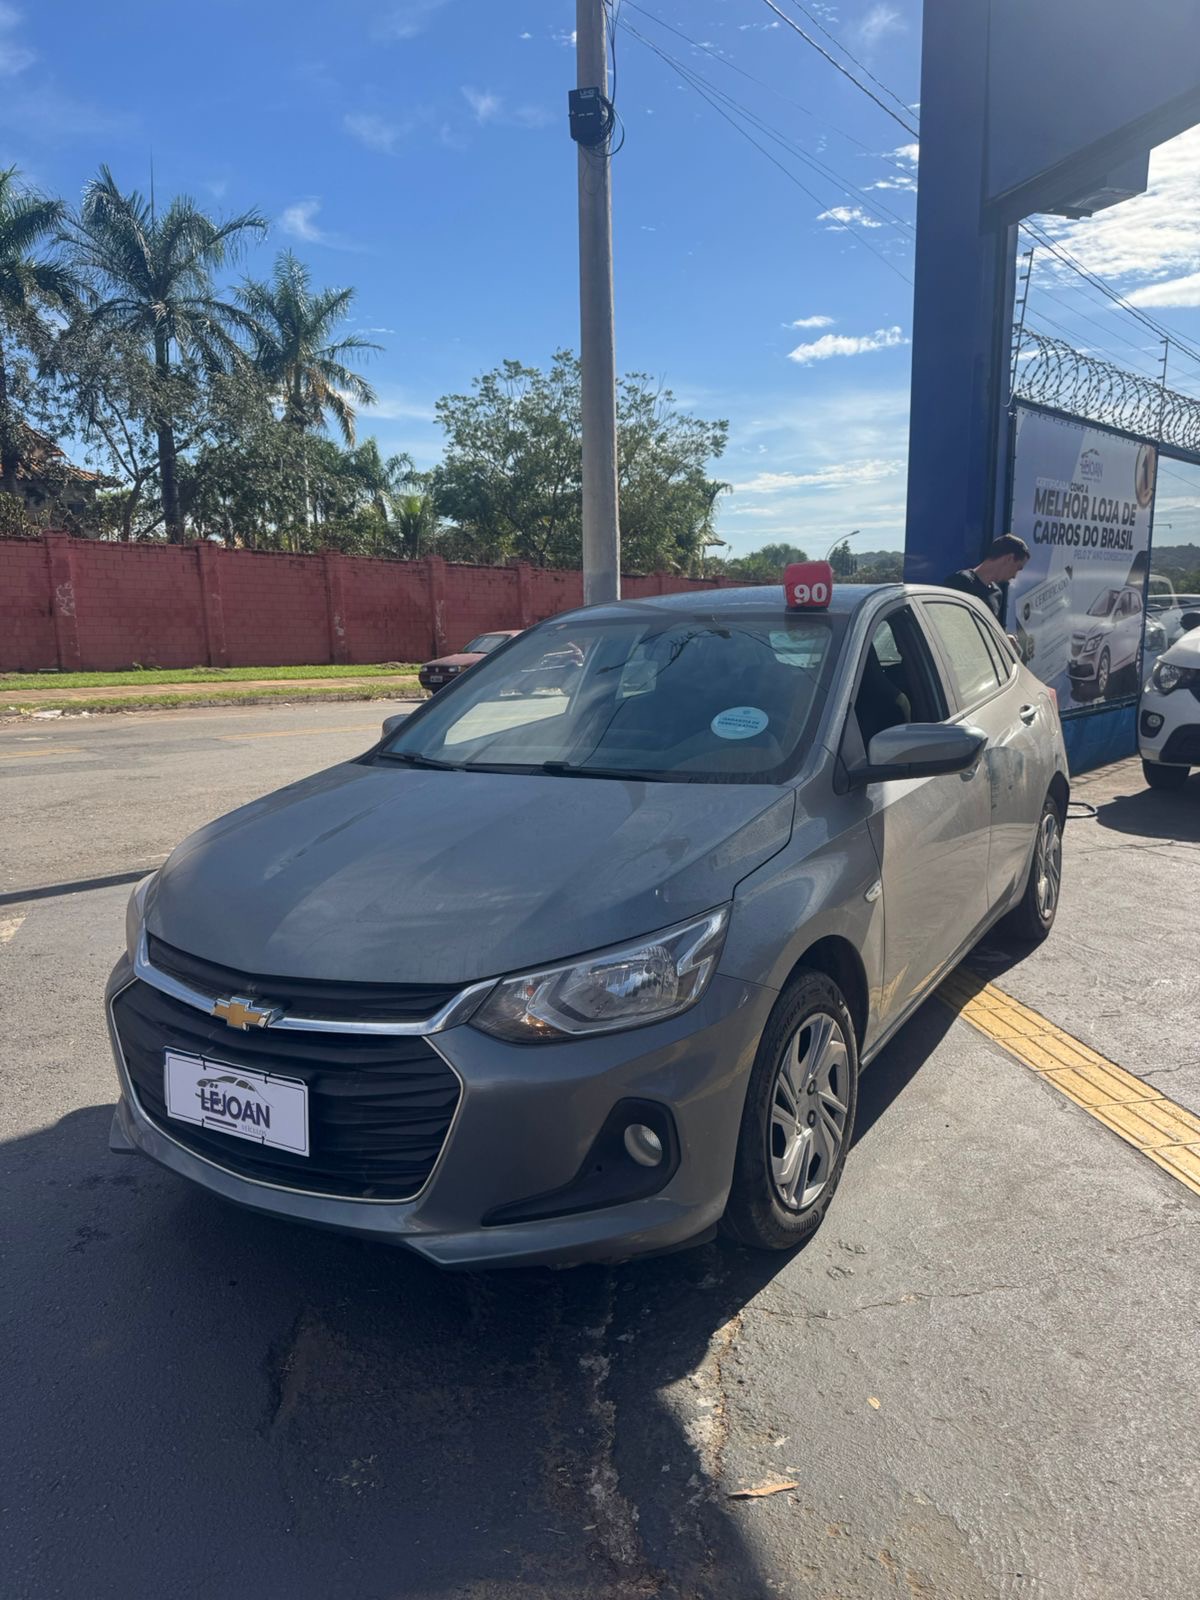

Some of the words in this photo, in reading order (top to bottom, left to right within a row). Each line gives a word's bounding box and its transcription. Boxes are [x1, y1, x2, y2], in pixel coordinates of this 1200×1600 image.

[1070, 482, 1085, 493] COMO
[1033, 488, 1089, 520] MELHOR
[1091, 496, 1119, 524] LOJA
[1121, 502, 1137, 526] DE
[1033, 520, 1081, 546] CARROS
[1082, 525, 1099, 547] DO
[1100, 527, 1133, 550] BRASIL
[794, 582, 828, 604] 90
